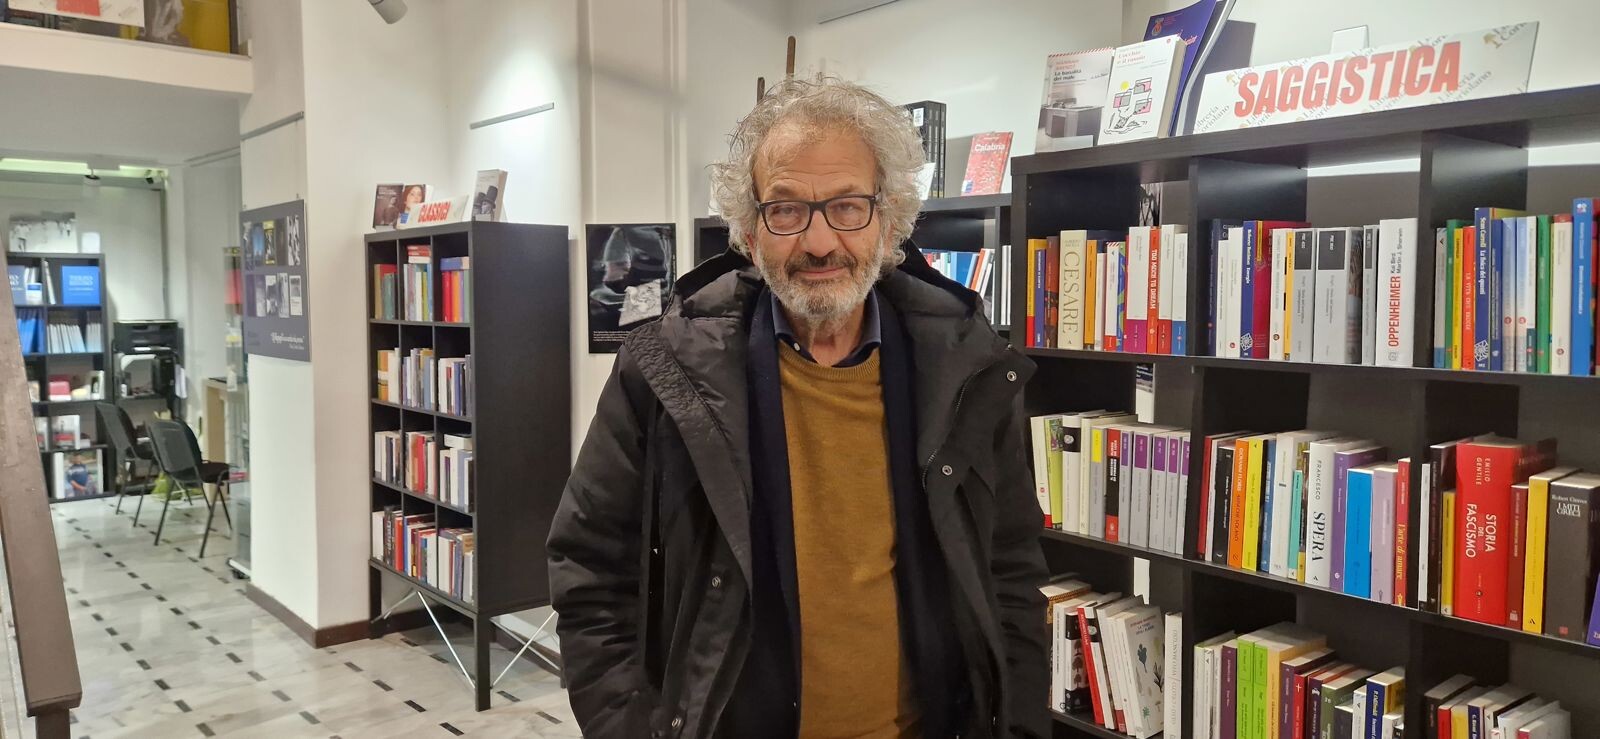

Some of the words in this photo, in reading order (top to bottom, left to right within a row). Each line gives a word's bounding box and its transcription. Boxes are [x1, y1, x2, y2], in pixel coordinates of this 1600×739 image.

[1234, 41, 1461, 118] SAGGISTICA
[974, 143, 1006, 152] Calabria
[1062, 251, 1081, 334] CESARE
[1151, 279, 1157, 288] TO
[1388, 275, 1401, 348] OPPENHEIMER
[1551, 494, 1568, 502] Robert
[1569, 496, 1588, 505] Graves
[1556, 508, 1581, 518] GRECI
[1563, 502, 1580, 512] MITI
[1311, 511, 1326, 562] SPERA
[1465, 503, 1478, 558] FASCISMO
[1485, 513, 1497, 553] STORIA
